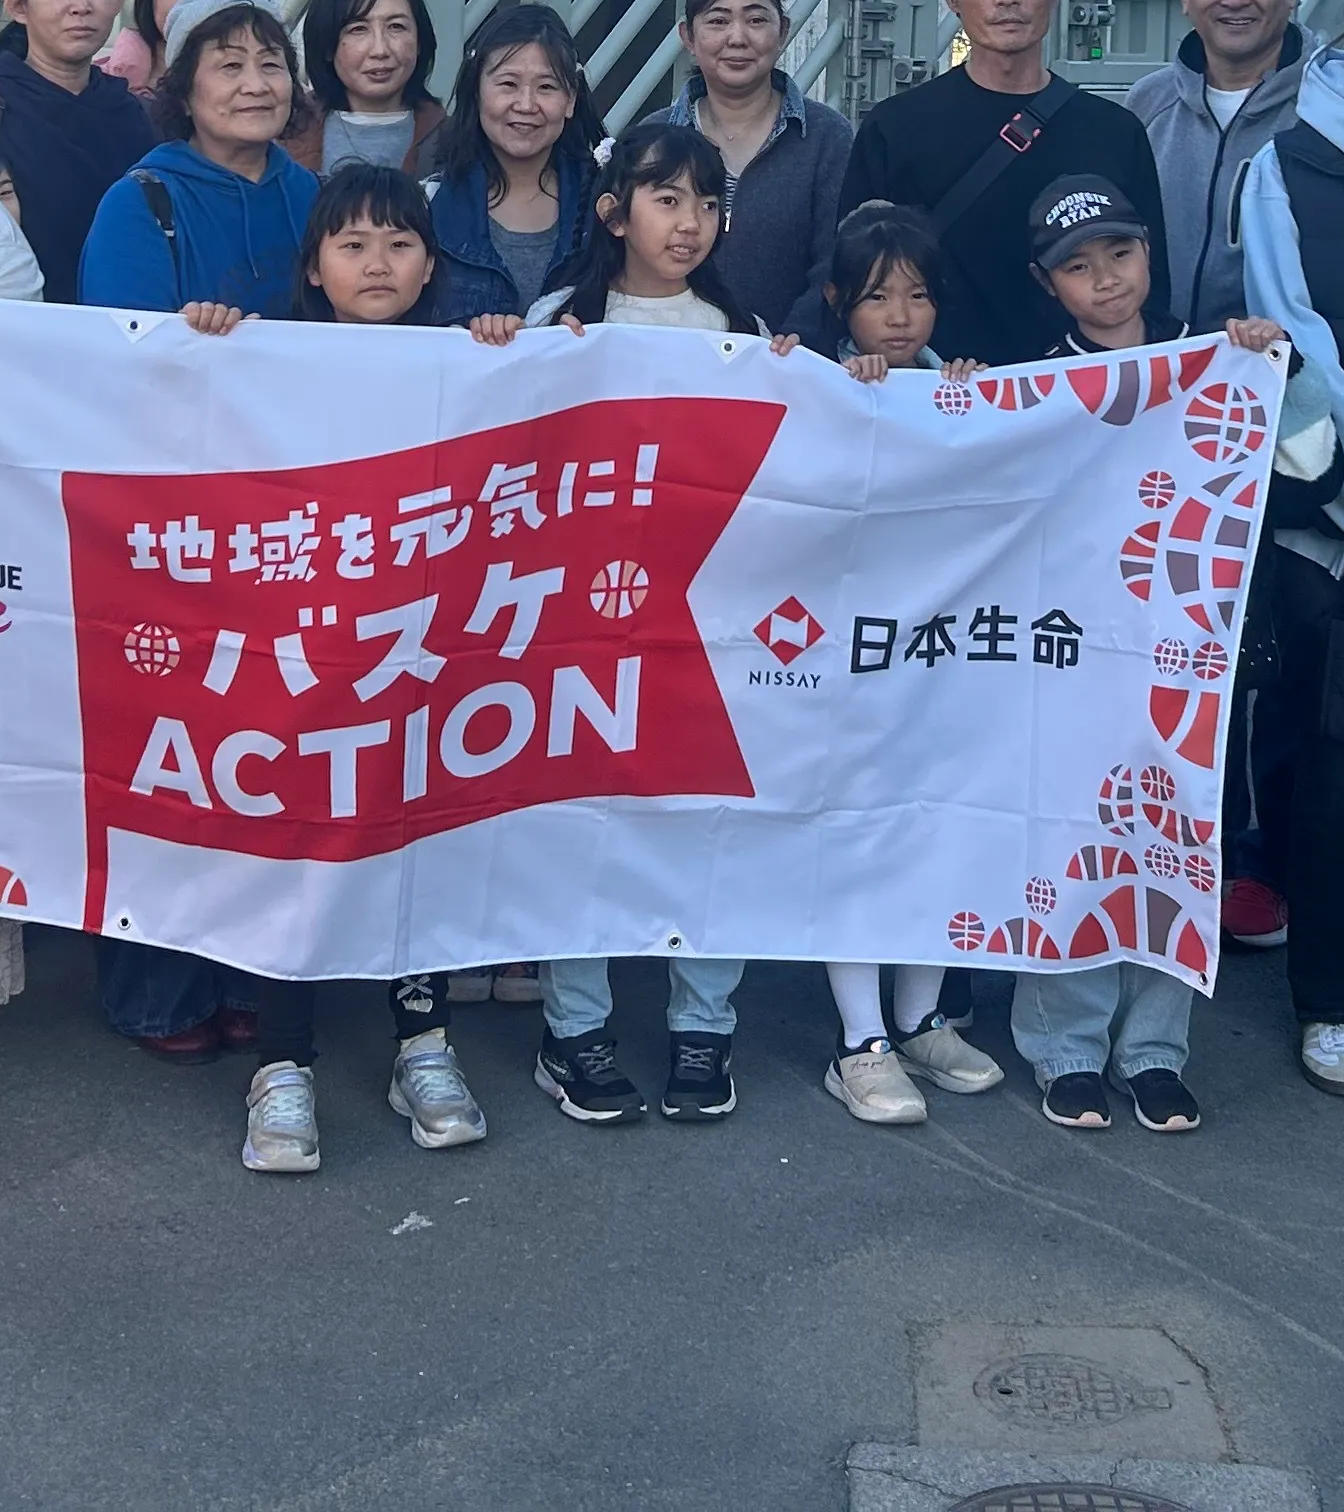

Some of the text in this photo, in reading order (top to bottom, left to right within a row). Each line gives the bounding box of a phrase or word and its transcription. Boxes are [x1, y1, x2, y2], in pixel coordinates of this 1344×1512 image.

[1045, 192, 1112, 225] CHOONSIK
[1059, 205, 1101, 228] RYAN
[127, 444, 659, 584] 地域を元気に!
[203, 560, 565, 702] バスケ
[850, 605, 1083, 674] 日本生命
[749, 670, 821, 689] NISSAY
[129, 656, 641, 818] ACTION
